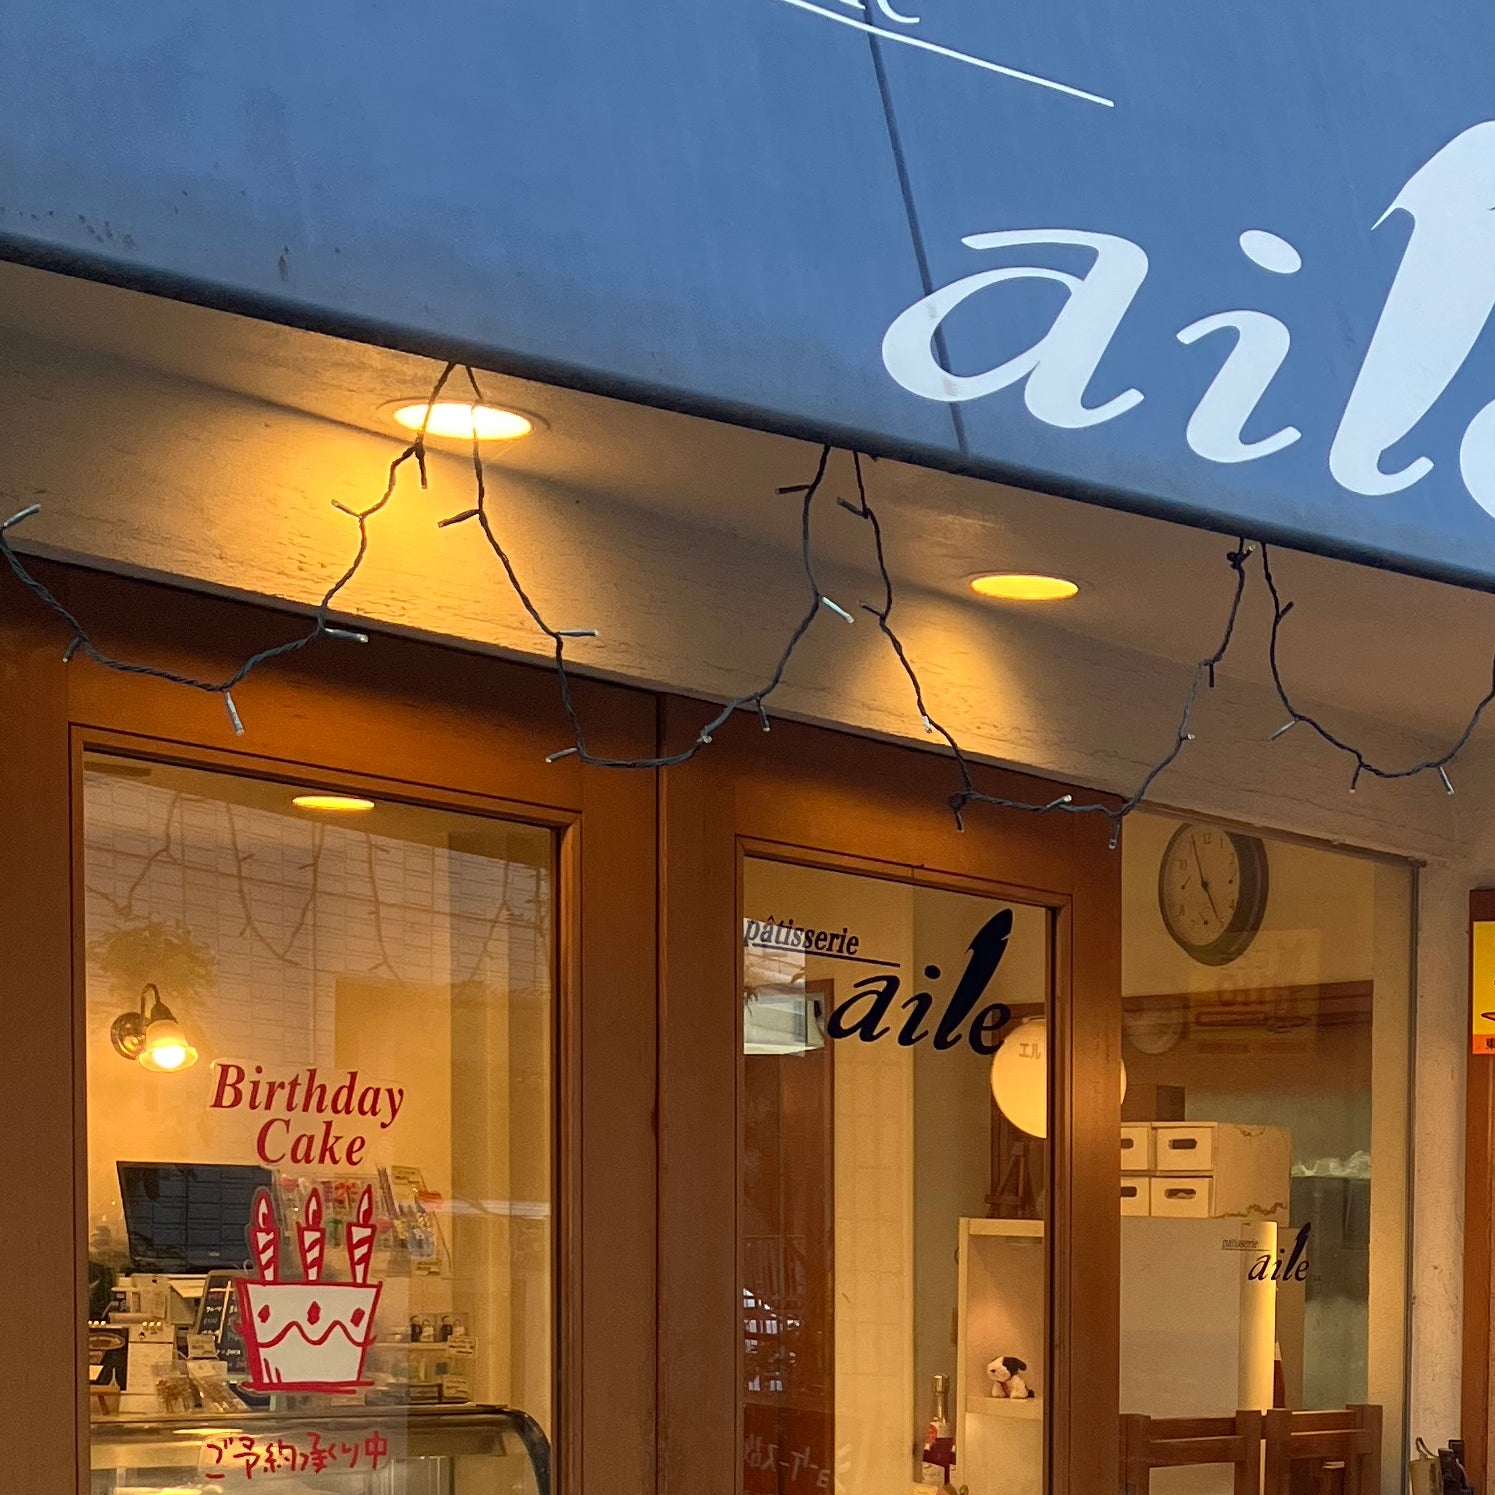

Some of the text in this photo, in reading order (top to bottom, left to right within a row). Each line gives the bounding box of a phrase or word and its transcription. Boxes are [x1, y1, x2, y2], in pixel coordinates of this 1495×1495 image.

[744, 915, 859, 955] pâtisserie
[827, 908, 1013, 1055] aile
[1019, 1042, 1041, 1060] エル
[210, 1063, 404, 1129] Birthday
[256, 1118, 366, 1166] Cake
[1248, 1221, 1312, 1281] aile
[206, 1430, 388, 1479] ご予約承り中
